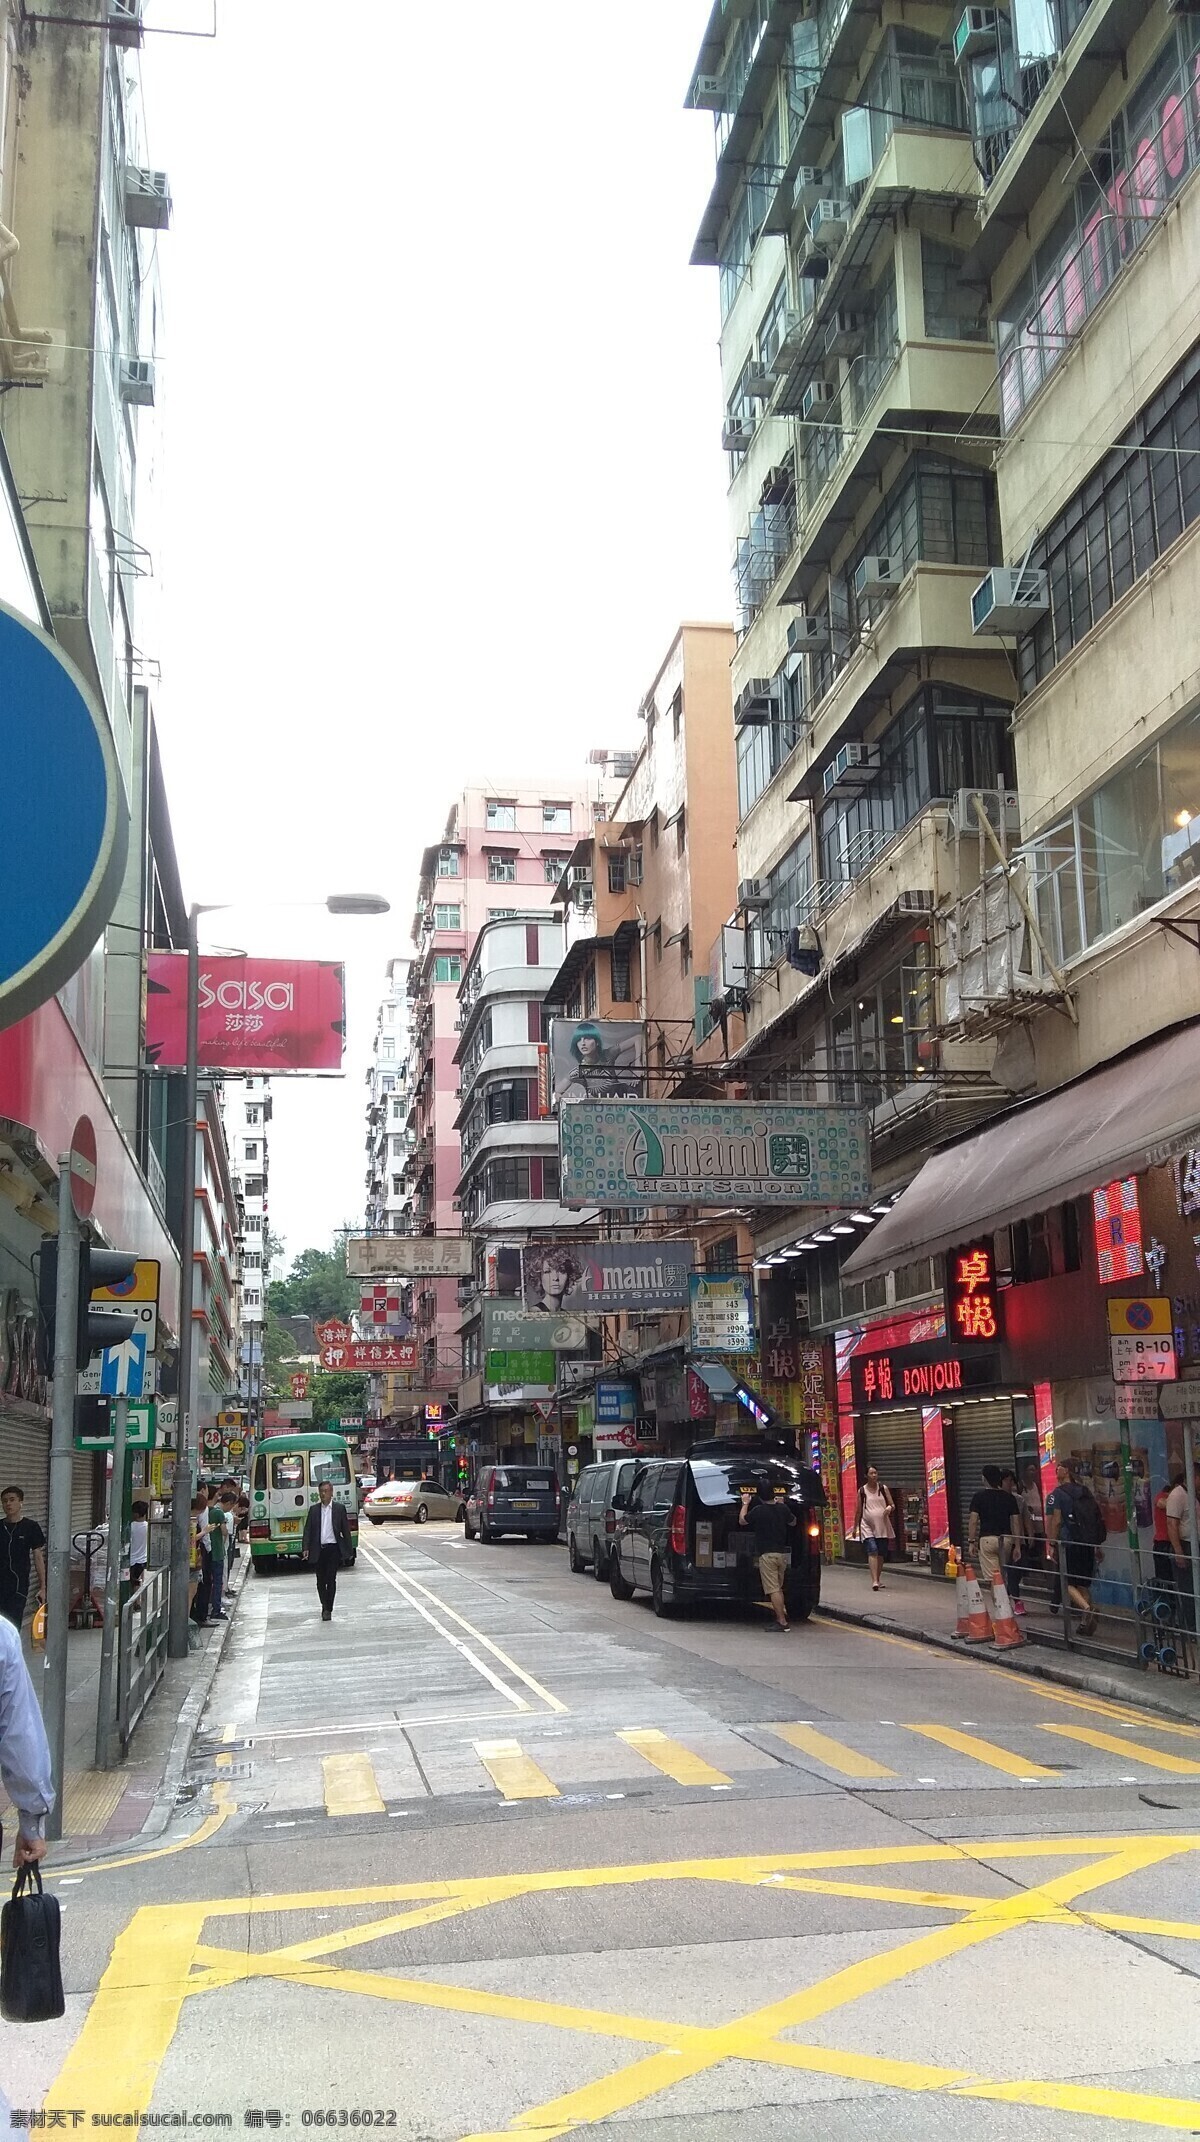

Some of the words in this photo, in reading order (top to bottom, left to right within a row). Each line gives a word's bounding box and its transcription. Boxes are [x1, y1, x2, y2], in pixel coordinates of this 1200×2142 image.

[225, 1013, 264, 1032] 莎莎
[200, 1037, 231, 1050] making
[231, 1036, 248, 1049] life
[250, 1038, 288, 1050] beautiful
[624, 1110, 770, 1177] Amami
[636, 1179, 703, 1194] Hair
[713, 1179, 803, 1194] Salon
[359, 1240, 462, 1265] 中英藥房
[581, 1256, 664, 1292] Amami
[588, 1293, 626, 1301] Hair
[631, 1291, 683, 1299] Salon
[725, 1300, 739, 1309] $43
[726, 1312, 739, 1321] $82
[1115, 1347, 1133, 1356] 上午
[1135, 1340, 1171, 1354] 8-10
[325, 1346, 344, 1367] 押
[903, 1360, 962, 1397] BONJOUR
[1116, 1368, 1135, 1376] 下午
[801, 1350, 824, 1420] 夢妮卡
[206, 1432, 219, 1443] 28
